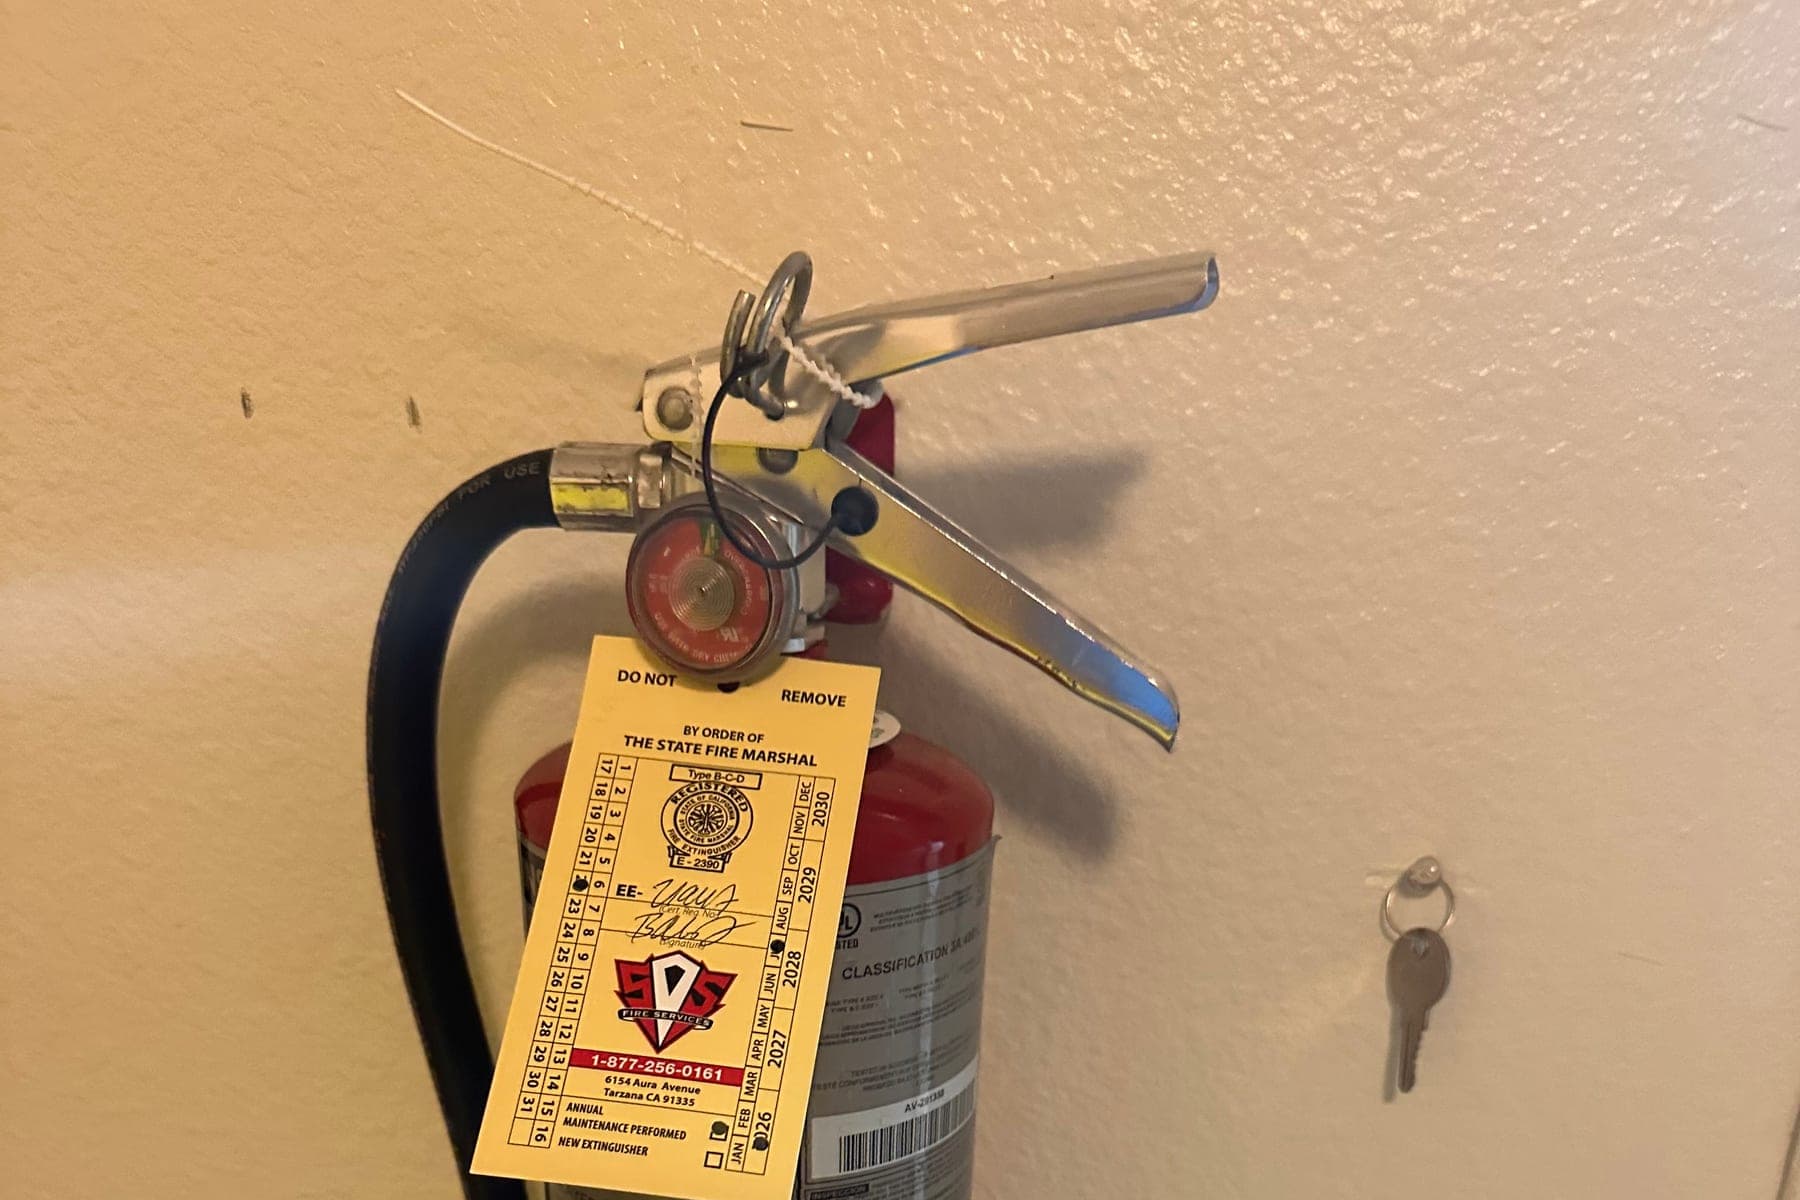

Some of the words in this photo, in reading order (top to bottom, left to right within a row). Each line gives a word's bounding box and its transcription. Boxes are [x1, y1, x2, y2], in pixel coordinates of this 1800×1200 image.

[503, 461, 541, 480] USE
[617, 669, 642, 683] DO
[644, 671, 678, 687] NOT
[781, 688, 847, 708] REMOVE
[683, 725, 700, 737] BY
[701, 727, 745, 742] ORDER
[747, 732, 765, 744] OF
[624, 735, 654, 749] THE
[656, 738, 702, 755] STATE
[705, 744, 739, 759] FIRE
[741, 748, 817, 767] MARSHAL
[601, 760, 613, 774] 17
[688, 768, 712, 780] Type
[714, 771, 745, 783] B-C-D
[595, 783, 608, 796] 18
[615, 786, 626, 795] 2
[670, 781, 749, 812] REGISTERED
[799, 781, 812, 802] DEC
[590, 806, 602, 820] 19
[610, 810, 621, 818] 3
[793, 811, 806, 834] NOV
[584, 827, 598, 843] 20
[604, 833, 616, 842] 4
[681, 835, 741, 856] EXTINGUISHER
[788, 843, 800, 864] OCT
[579, 851, 592, 865] 21
[694, 858, 720, 869] 2390
[594, 880, 606, 889] 6
[615, 883, 643, 898] EE-
[782, 876, 794, 895] SEP
[568, 898, 581, 914] 23
[589, 904, 600, 913] 7
[776, 907, 788, 929] AUG
[562, 922, 576, 938] 24
[583, 928, 595, 936] 8
[557, 946, 570, 963] 25
[578, 953, 589, 961] 9
[842, 943, 949, 980] CLASSIFICATION
[551, 971, 565, 987] 26
[752, 1112, 772, 1151] 026
[767, 1029, 787, 1069] 2027
[782, 951, 801, 988] 2028
[798, 867, 816, 904] 2029
[812, 792, 830, 827] 2030
[571, 974, 584, 989] 10
[764, 973, 776, 994] JUN
[545, 995, 559, 1012] 27
[564, 999, 578, 1013] 11
[622, 1009, 650, 1019] FIRE
[653, 1011, 712, 1027] SERVICES
[757, 1004, 770, 1028] MAY
[539, 1020, 553, 1037] 28
[559, 1024, 573, 1039] 12
[534, 1046, 547, 1062] 29
[553, 1049, 567, 1064] 13
[751, 1039, 764, 1061] APR
[591, 1054, 723, 1081] 1-877-256-0161
[527, 1071, 541, 1088] 30
[547, 1074, 561, 1090] 14
[604, 1075, 631, 1086] 6154
[632, 1079, 658, 1090] Aura
[660, 1082, 701, 1095] Avenue
[744, 1071, 758, 1096] MAR
[521, 1097, 535, 1112] 31
[603, 1087, 644, 1101] Tarzana
[646, 1093, 661, 1103] CA
[663, 1096, 695, 1107] 91335
[541, 1100, 555, 1116] 15
[566, 1102, 604, 1116] ANNUAL
[738, 1108, 751, 1129] FEB
[535, 1126, 549, 1142] 16
[563, 1116, 629, 1135] MAINTENANCE
[630, 1124, 687, 1141] PERFORMED
[558, 1136, 581, 1149] NEW
[581, 1139, 649, 1157] EXTINGUISHER
[731, 1142, 745, 1165] JAN
